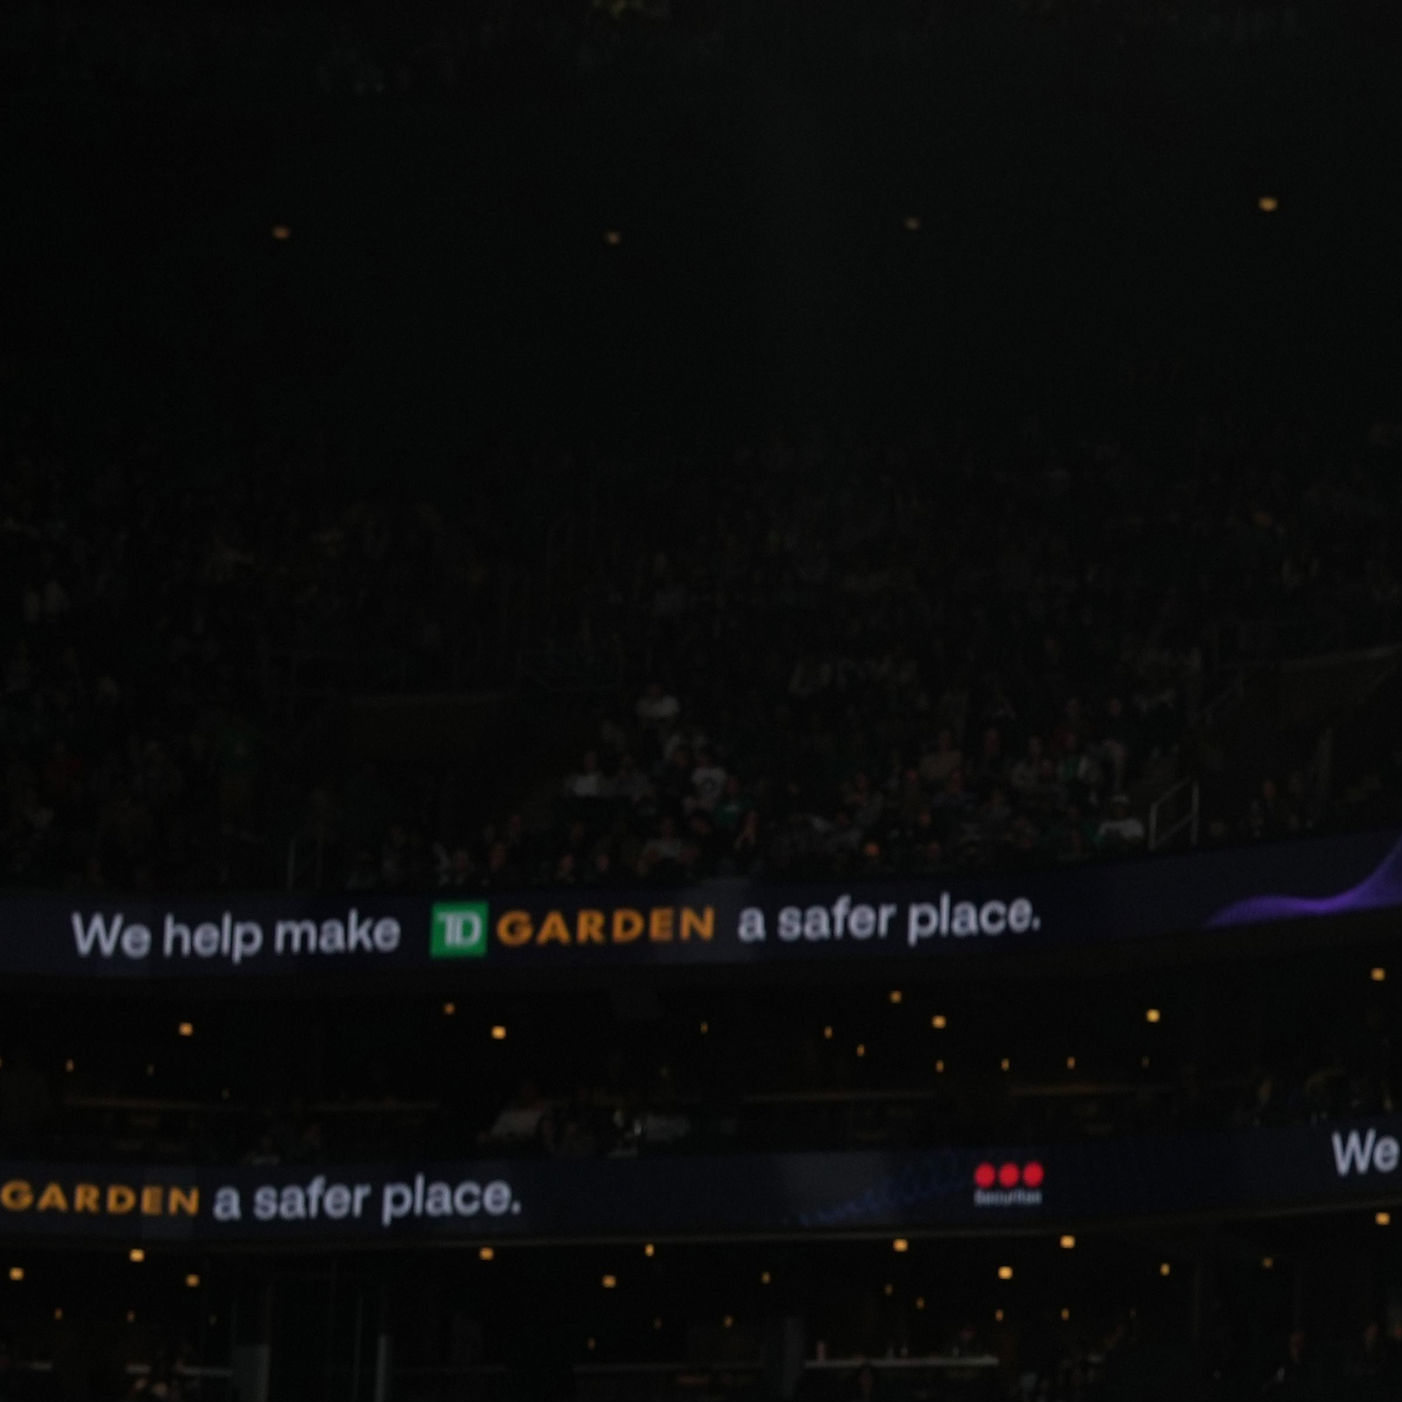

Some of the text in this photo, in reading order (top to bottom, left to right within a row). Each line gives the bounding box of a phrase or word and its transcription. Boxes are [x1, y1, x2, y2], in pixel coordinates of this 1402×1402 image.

[72, 892, 1042, 963] We help make TD GARDEN a safer place.
[1333, 1130, 1399, 1177] We
[213, 1187, 241, 1222] a
[251, 1176, 372, 1222] safer
[381, 1173, 522, 1228] place.
